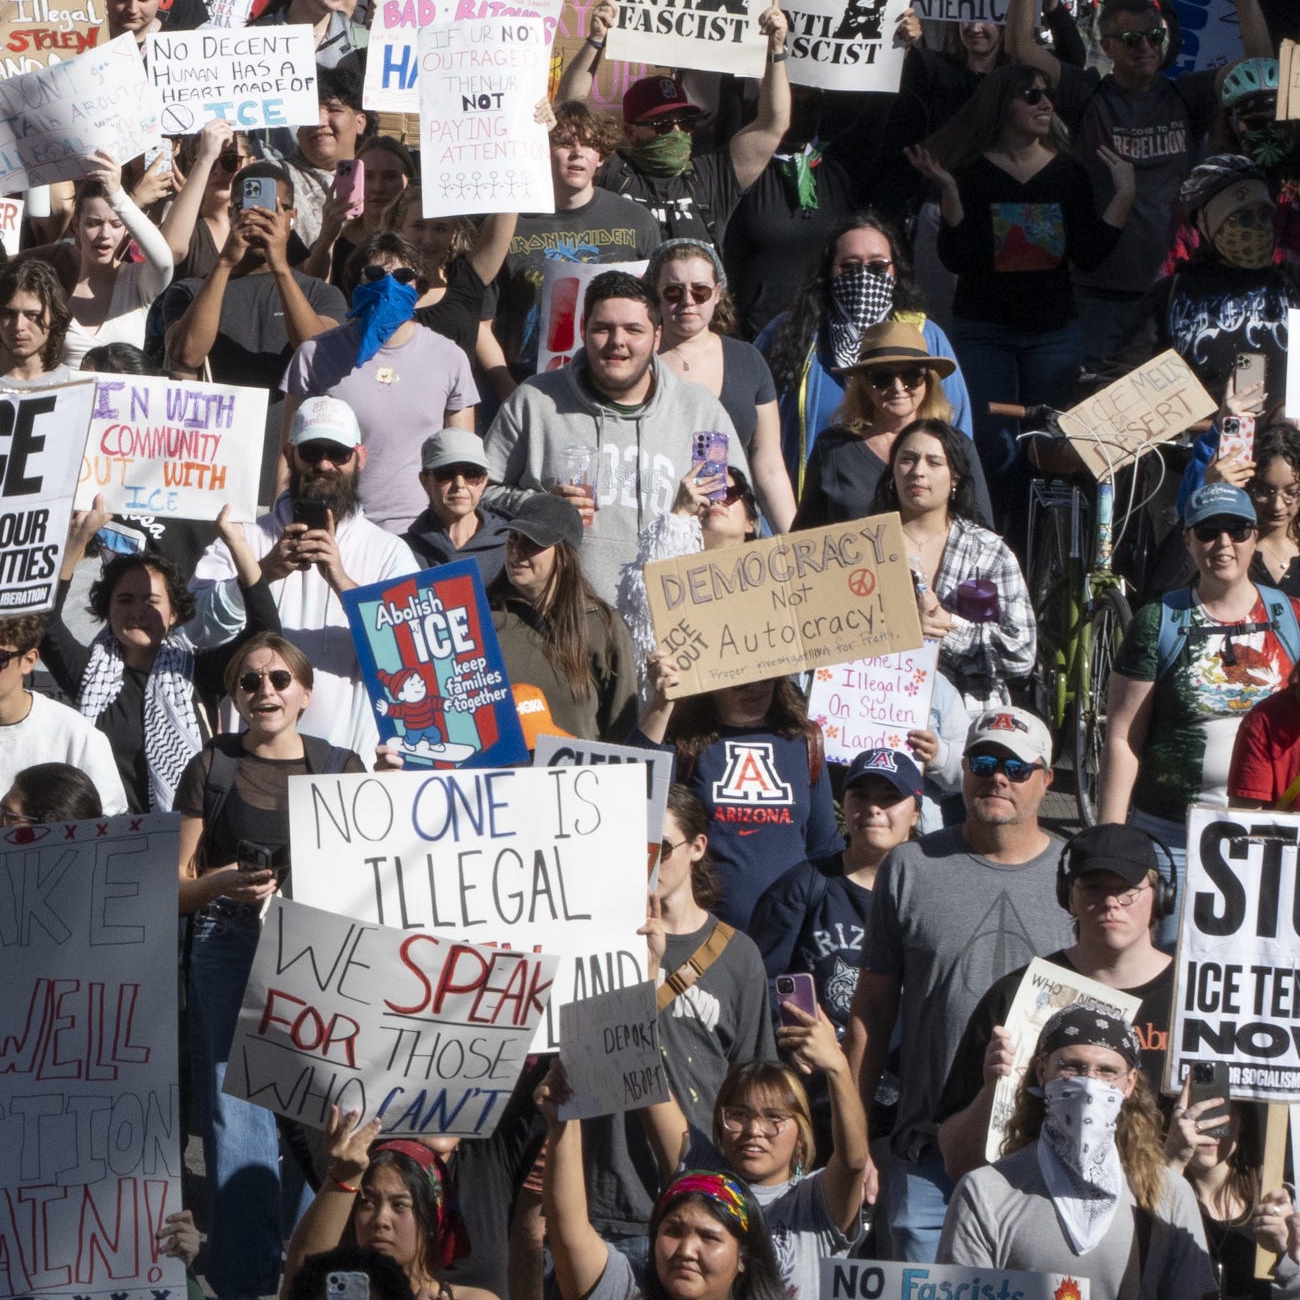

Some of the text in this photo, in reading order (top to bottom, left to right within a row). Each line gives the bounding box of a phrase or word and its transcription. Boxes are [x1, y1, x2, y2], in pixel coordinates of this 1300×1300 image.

[617, 9, 749, 43] FASCIST
[376, 588, 442, 631] Abolish
[413, 607, 475, 662] ICE
[452, 655, 488, 679] keep
[446, 670, 504, 699] families
[454, 685, 508, 712] together
[311, 769, 601, 849] NO ONE IS
[715, 806, 791, 825] ARIZONA
[366, 847, 591, 928] ILLEGAL
